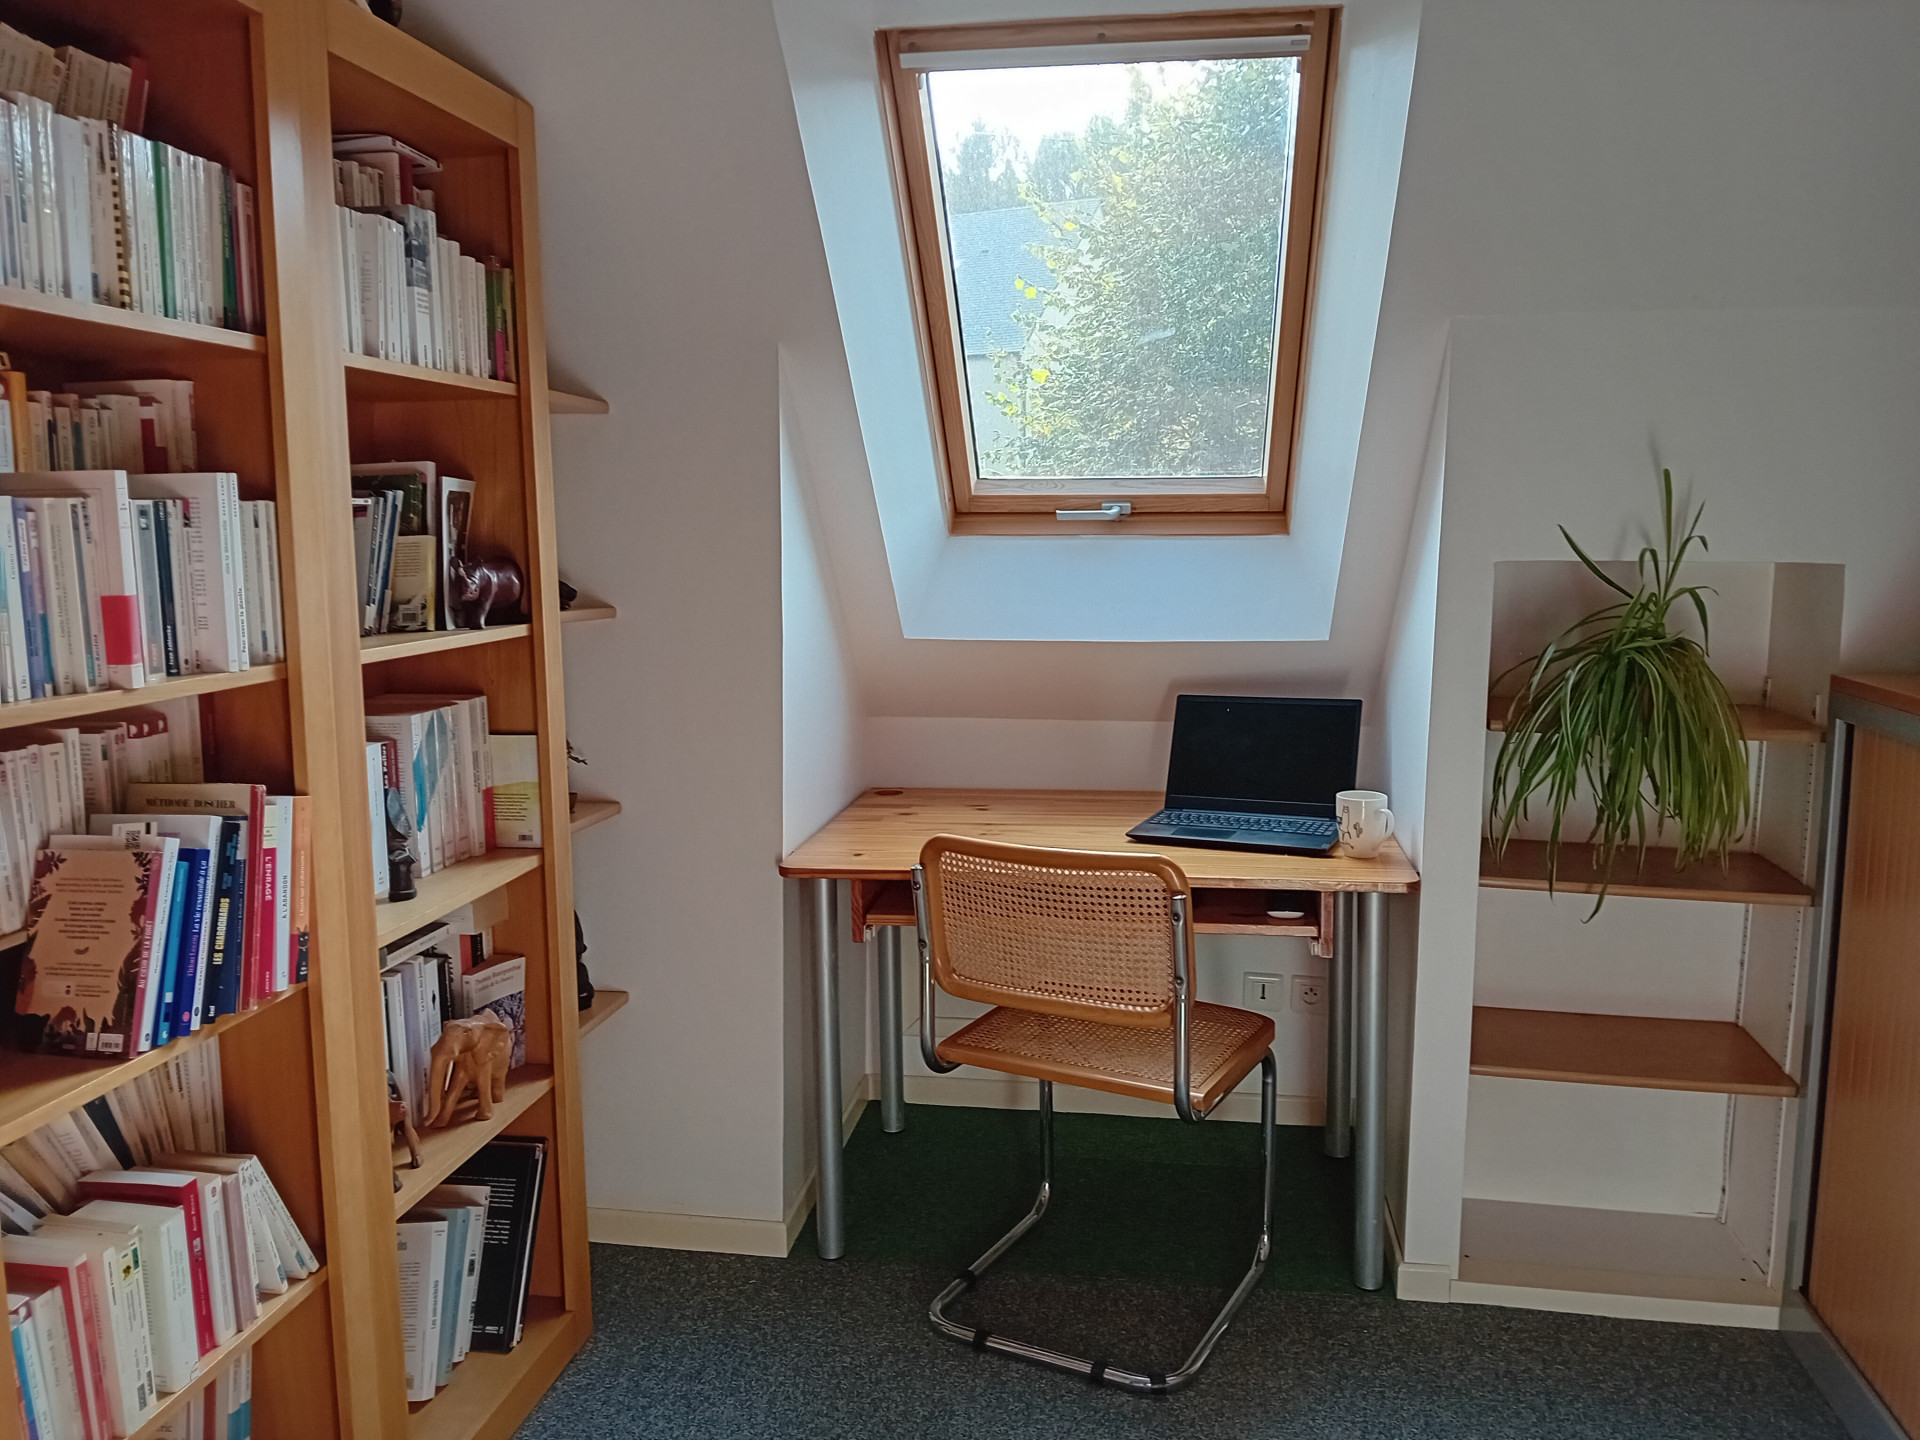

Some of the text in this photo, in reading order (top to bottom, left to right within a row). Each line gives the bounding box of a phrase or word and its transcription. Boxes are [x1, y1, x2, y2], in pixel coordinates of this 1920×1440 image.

[264, 856, 273, 902] L'ENRAGÉ
[194, 911, 202, 922] vie
[193, 923, 200, 933] La
[214, 897, 230, 951] CHAROGNARDS
[144, 940, 151, 950] LA
[212, 952, 223, 965] LES
